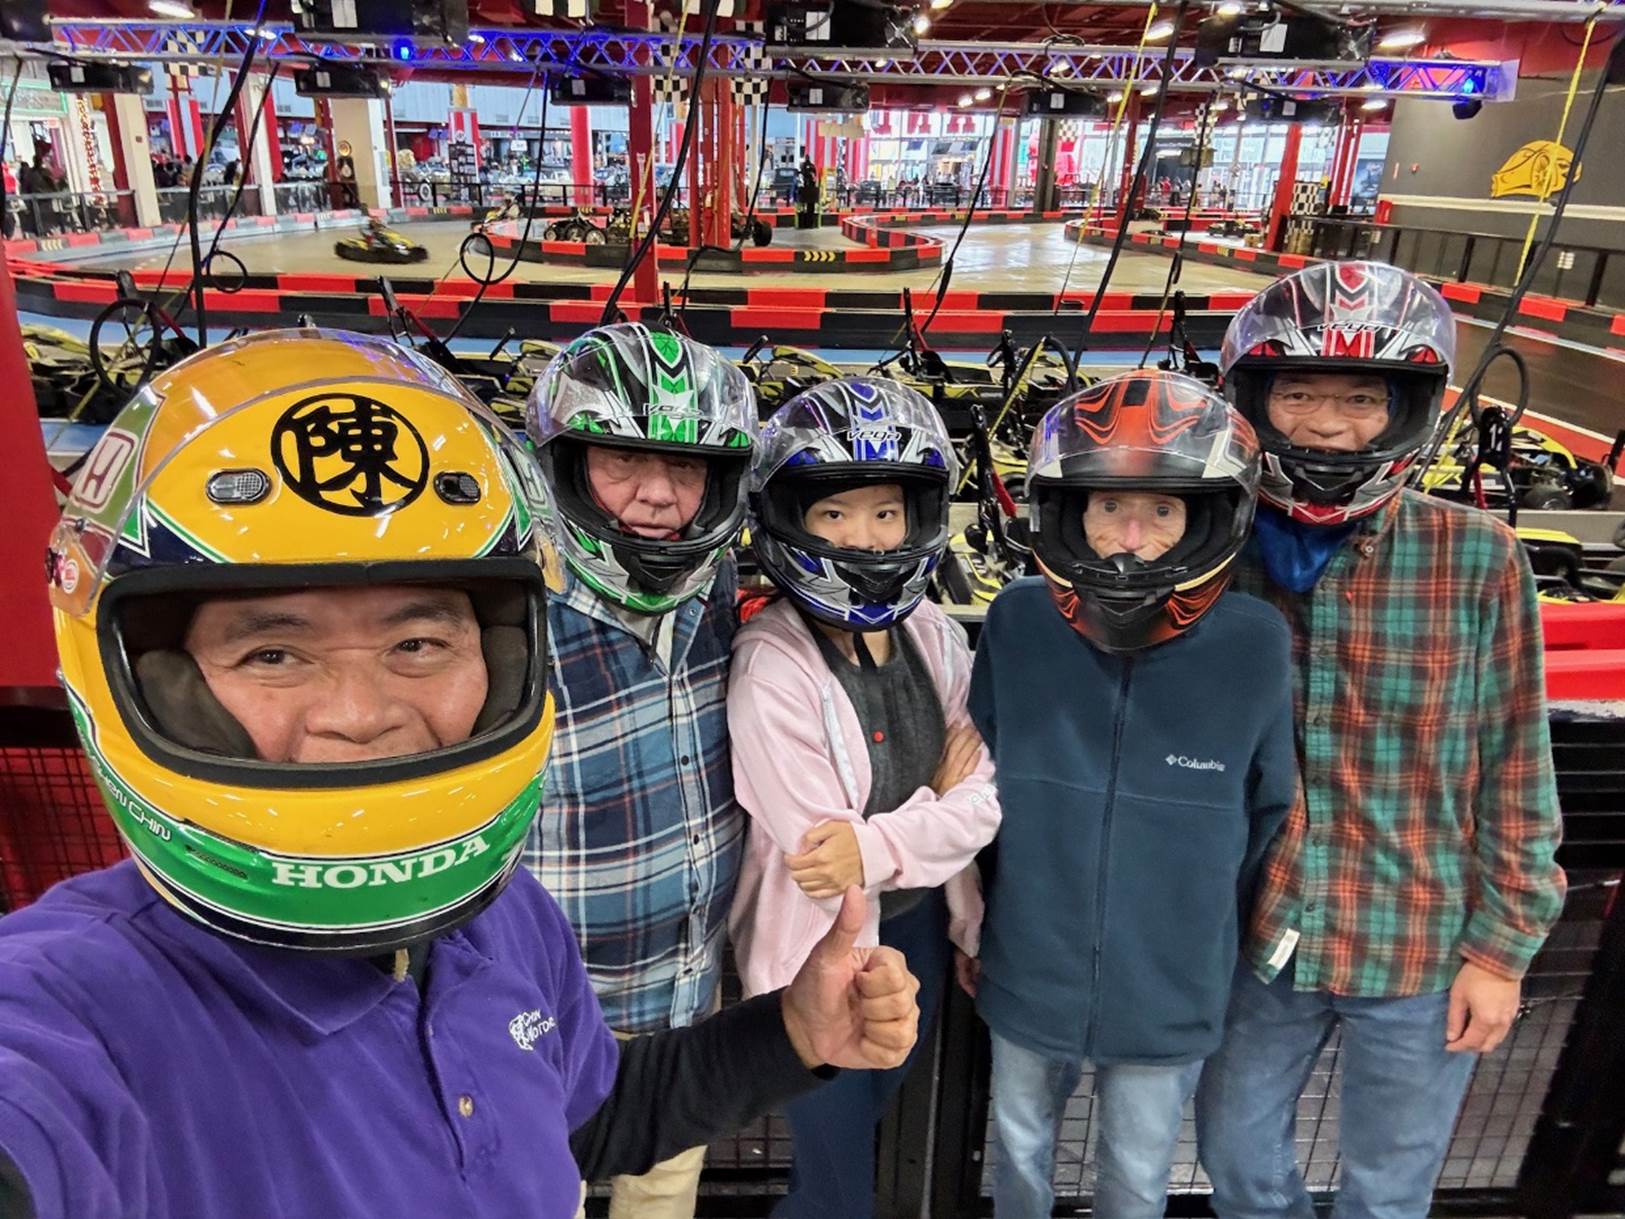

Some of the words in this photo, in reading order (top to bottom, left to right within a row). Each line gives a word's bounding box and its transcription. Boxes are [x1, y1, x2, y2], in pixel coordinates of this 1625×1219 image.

[846, 430, 902, 442] vega
[280, 396, 422, 512] 陳
[1177, 755, 1225, 772] Columbia
[271, 835, 491, 889] HONDA
